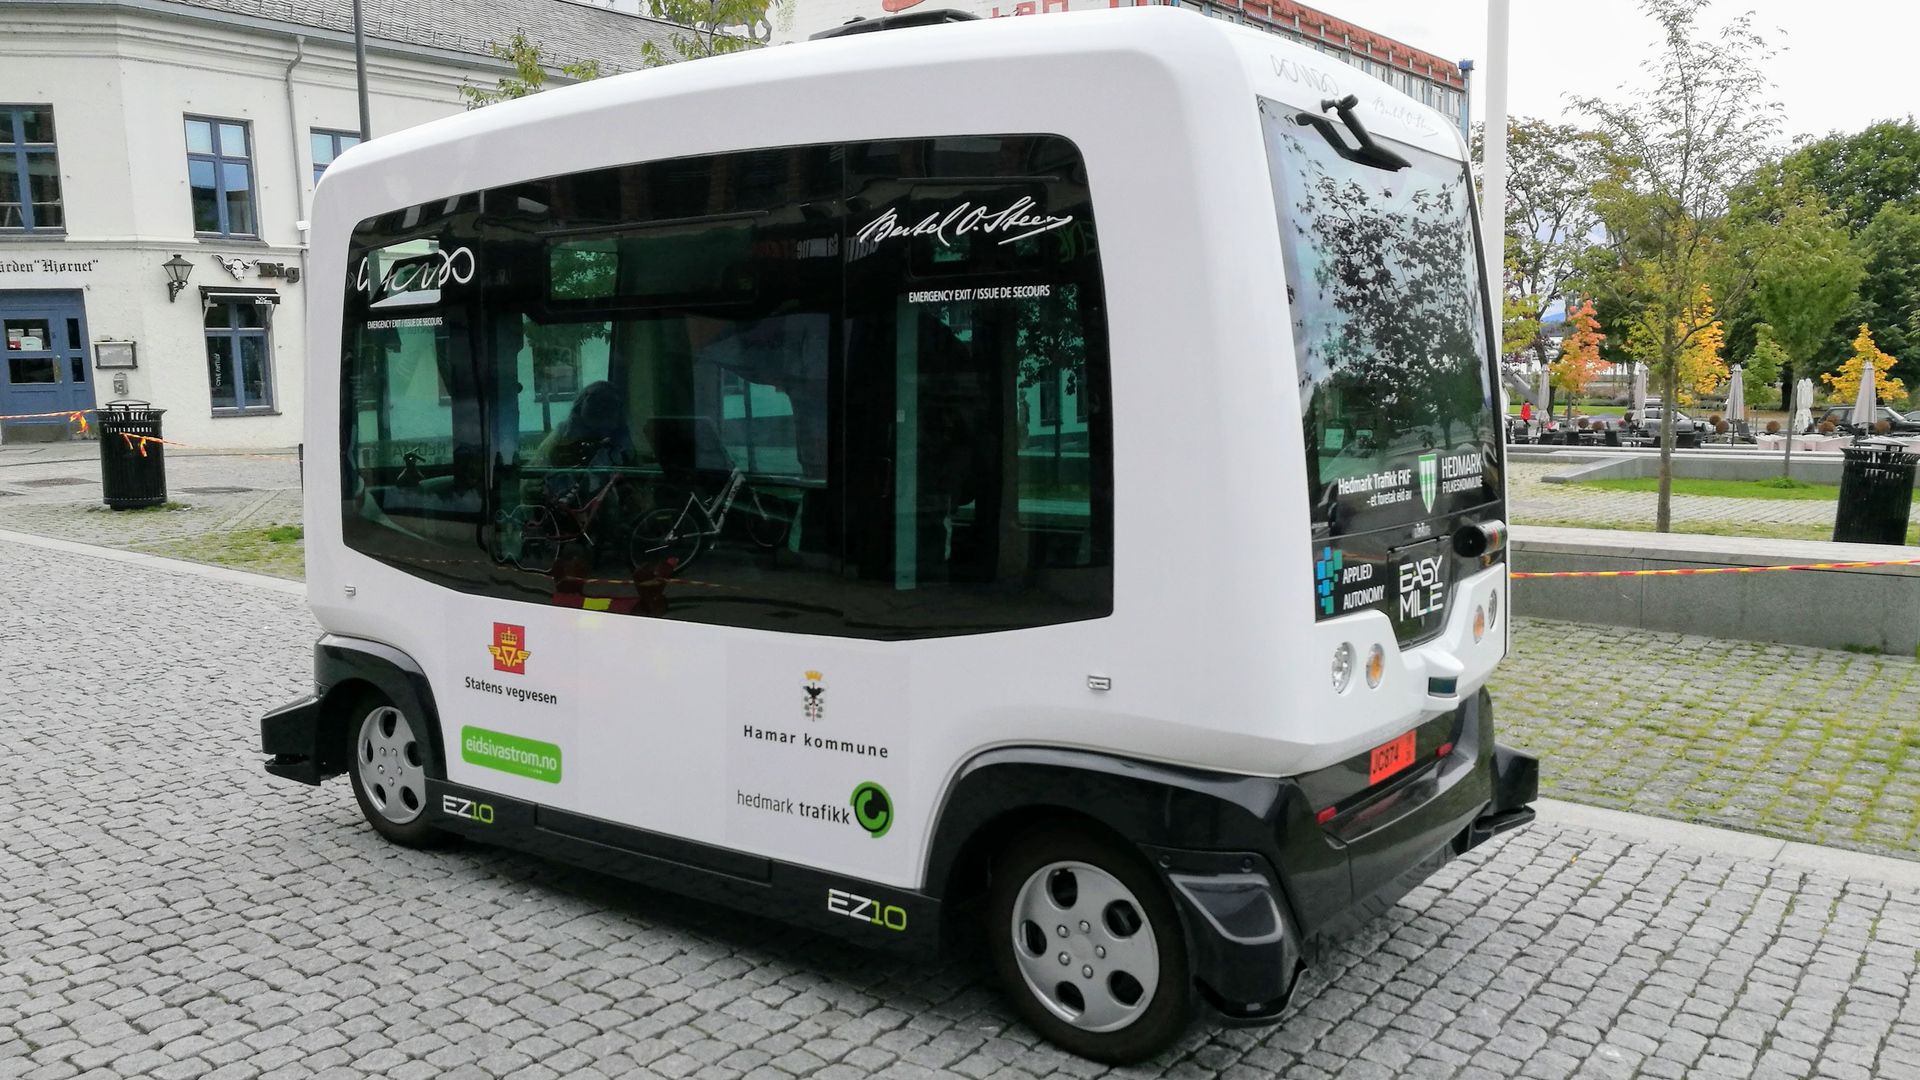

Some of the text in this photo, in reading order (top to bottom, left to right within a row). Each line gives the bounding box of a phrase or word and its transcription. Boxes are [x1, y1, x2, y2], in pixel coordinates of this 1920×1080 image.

[257, 262, 300, 283] Big
[909, 289, 954, 303] EMERGENCY
[954, 288, 972, 301] EXIT
[977, 287, 999, 300] ISSUE
[1000, 286, 1012, 298] DE
[1012, 284, 1050, 298] SECOURS
[367, 319, 391, 330] EMERGENCY
[1441, 452, 1483, 479] HEDMARK
[1338, 468, 1412, 495] Hedmark Trafikk FKF
[1377, 490, 1396, 505] foretak
[1396, 489, 1405, 503] eid
[1405, 489, 1412, 501] av
[1342, 563, 1373, 585] APPLIED
[1400, 555, 1443, 593] EASY
[1343, 585, 1385, 611] AUTONOMY
[1400, 582, 1444, 622] MILE
[465, 676, 557, 705] Statens vegvesen
[465, 734, 557, 772] eidsivastrom.no
[743, 724, 889, 759] Hamar kommune
[443, 794, 494, 824] EZ10
[737, 789, 851, 826] hedmark trafikk
[827, 888, 908, 931] EZ10
